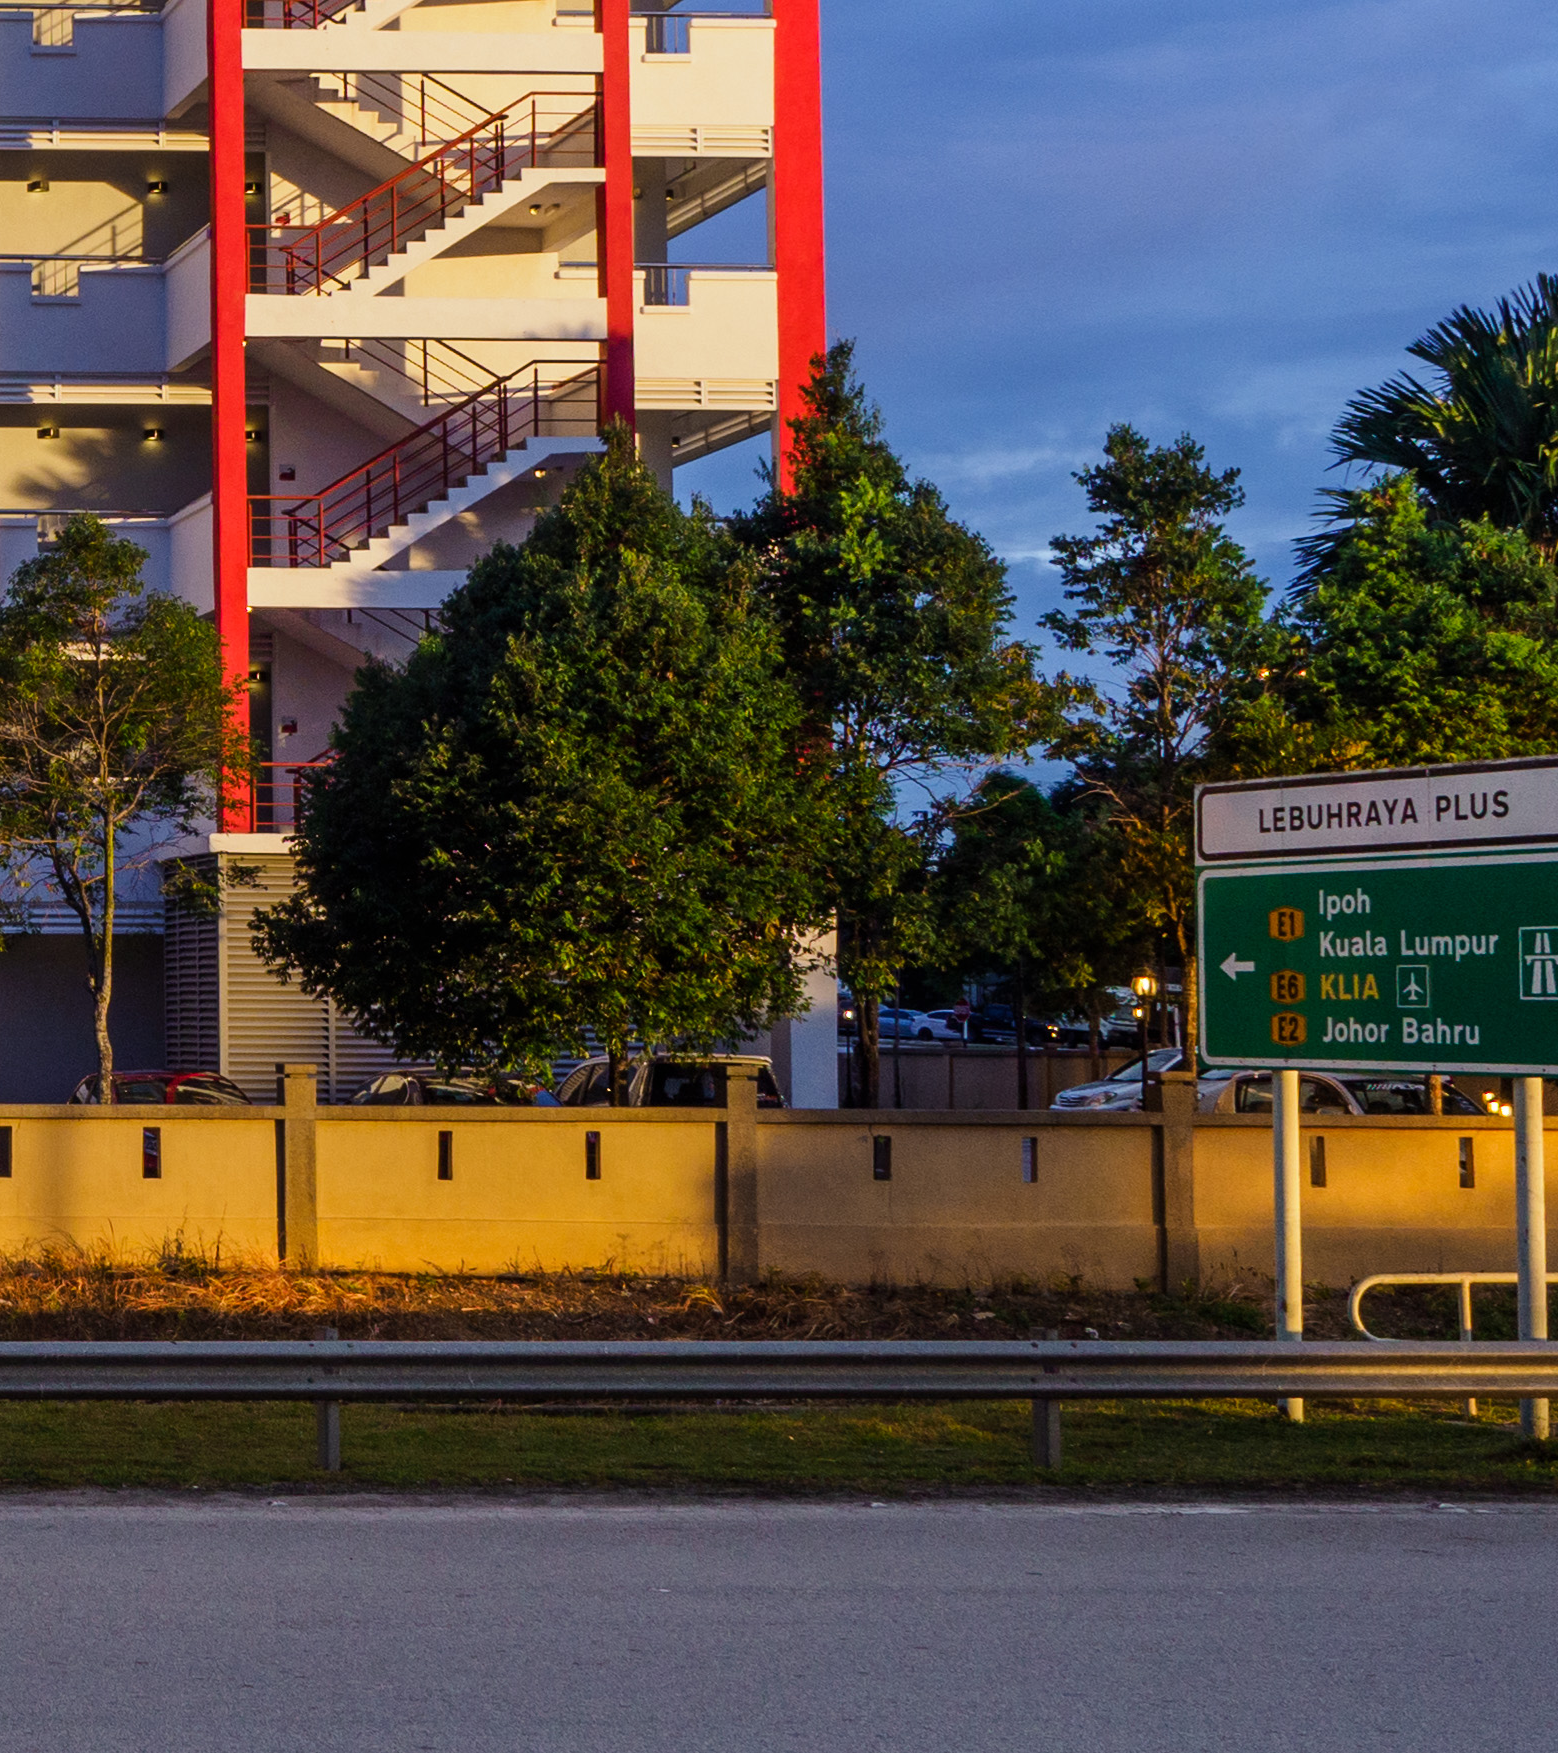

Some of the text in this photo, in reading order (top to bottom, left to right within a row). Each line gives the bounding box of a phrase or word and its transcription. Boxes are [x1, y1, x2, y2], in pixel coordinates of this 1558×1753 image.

[1259, 790, 1509, 833] LEBUHRAYA PLUS
[1319, 888, 1370, 921] Ipoh
[1278, 912, 1295, 937] E1
[1319, 930, 1499, 962] Kuala Lumpur
[1277, 975, 1298, 999] E6
[1320, 974, 1379, 1000] KLIA
[1278, 1017, 1298, 1041] E2
[1322, 1017, 1480, 1045] Johor Bahru
